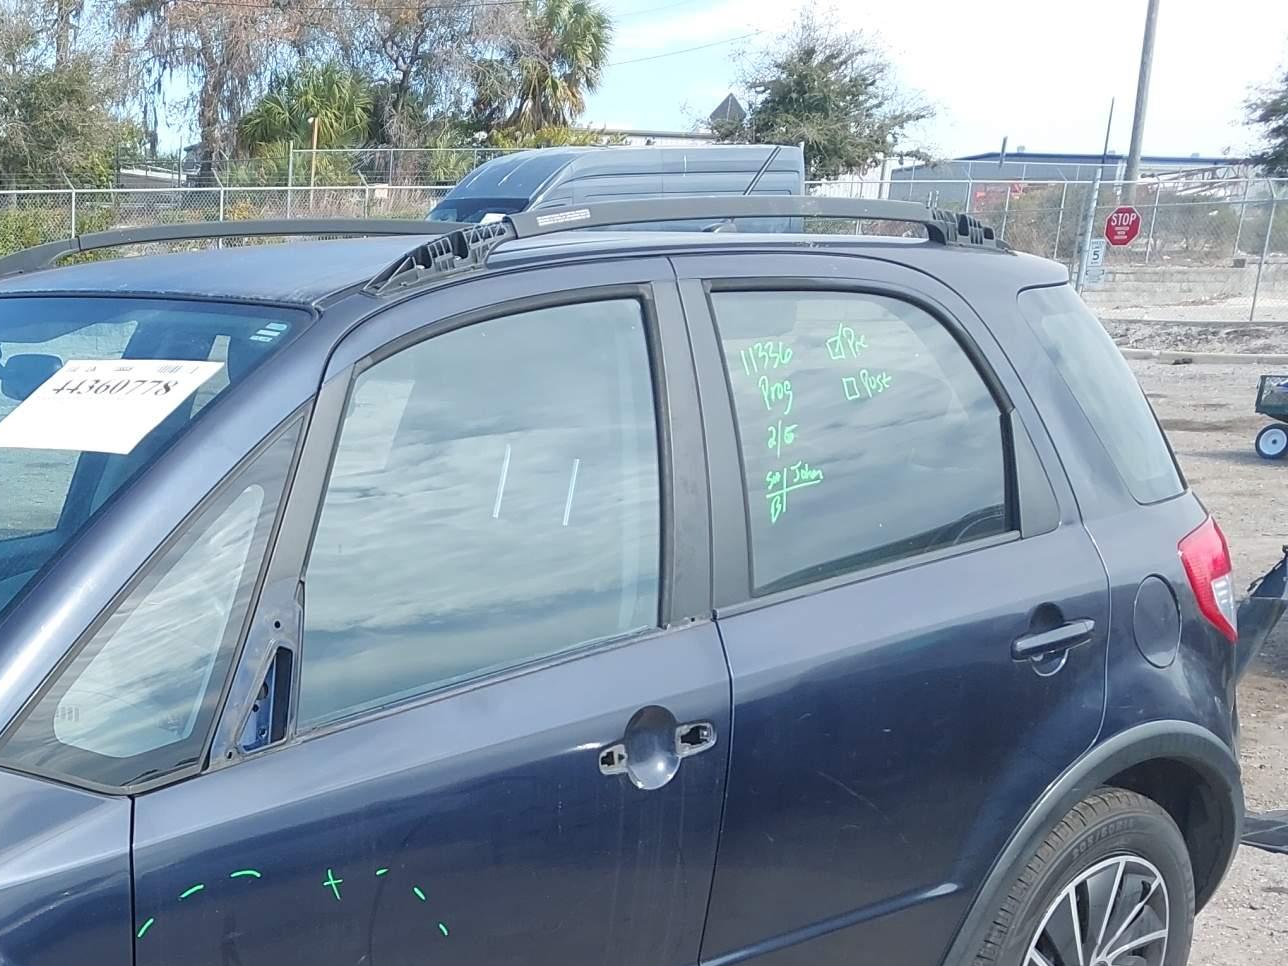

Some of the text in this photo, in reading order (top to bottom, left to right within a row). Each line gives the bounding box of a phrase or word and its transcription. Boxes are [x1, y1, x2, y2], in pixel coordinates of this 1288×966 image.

[1111, 213, 1136, 226] STOP
[1092, 250, 1100, 261] 5
[740, 341, 793, 376] 11336
[52, 379, 179, 396] 44360778
[758, 375, 793, 415] Prog
